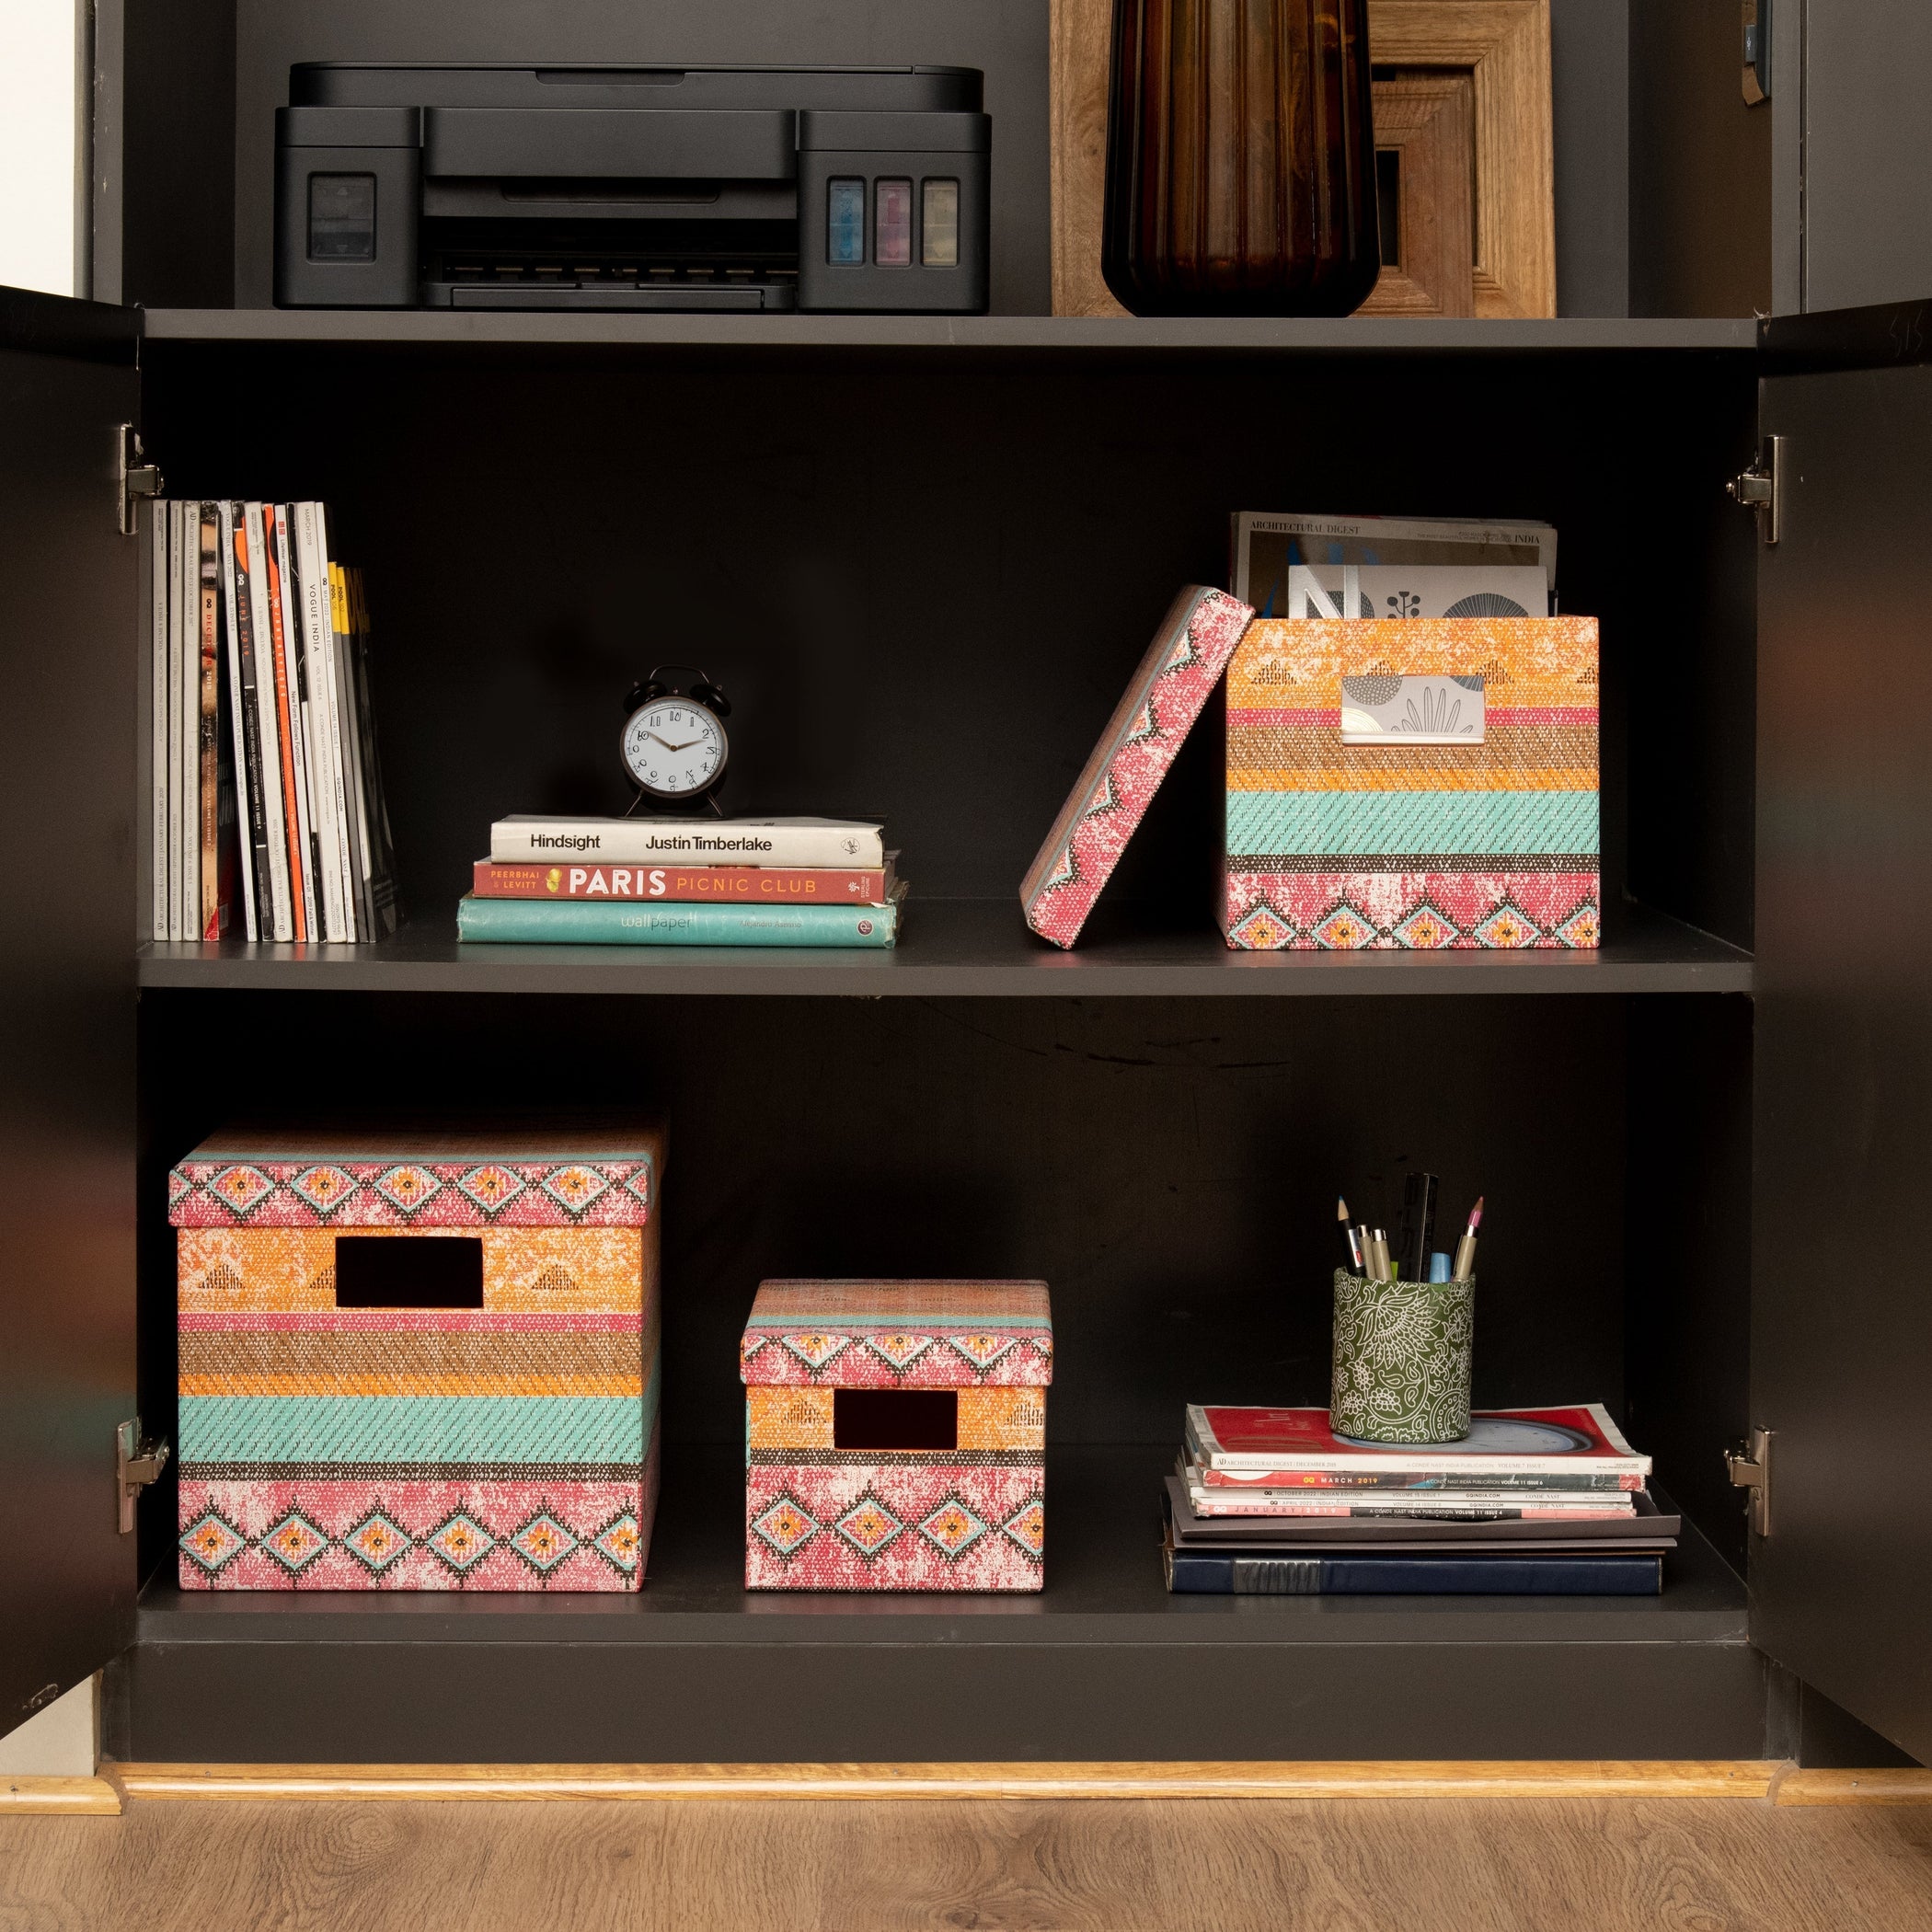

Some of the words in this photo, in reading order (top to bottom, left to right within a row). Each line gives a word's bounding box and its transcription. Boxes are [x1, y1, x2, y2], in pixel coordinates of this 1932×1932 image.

[303, 508, 311, 531] MARCH
[1250, 521, 1324, 533] ARCHITECTURAL
[1327, 523, 1361, 535] DIGEST
[1514, 534, 1540, 544] INDIA
[237, 573, 244, 585] GQ
[321, 577, 328, 585] GQ
[238, 594, 247, 622] JUNE
[308, 583, 317, 619] VOGUE
[241, 629, 249, 655] 2019
[311, 623, 320, 652] INDIA
[530, 834, 601, 851] Hindsight
[646, 834, 691, 850] Justin
[692, 836, 773, 851] Timberlake
[490, 870, 540, 879] PEERBHAI
[569, 868, 666, 896] PARIS
[676, 878, 749, 891] PICNIC
[760, 880, 816, 892] CLUB
[503, 880, 536, 889] LEVITT
[620, 914, 691, 931] wallpaper
[1216, 1457, 1226, 1466] AD
